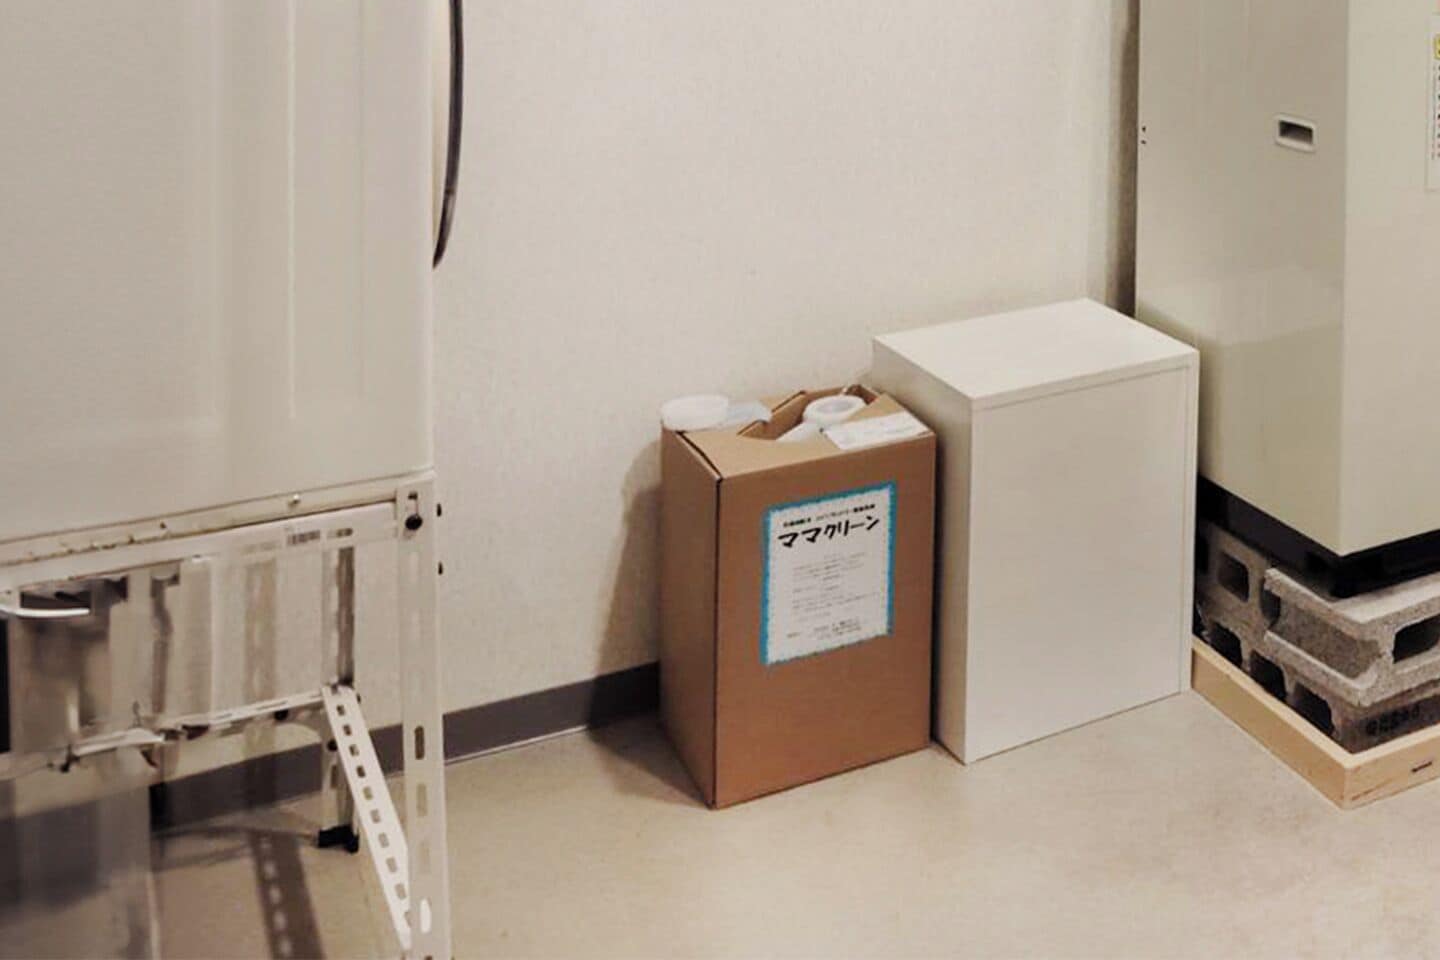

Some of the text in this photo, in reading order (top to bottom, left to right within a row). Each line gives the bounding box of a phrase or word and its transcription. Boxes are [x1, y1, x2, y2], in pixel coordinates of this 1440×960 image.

[777, 514, 880, 548] ママクリーン
